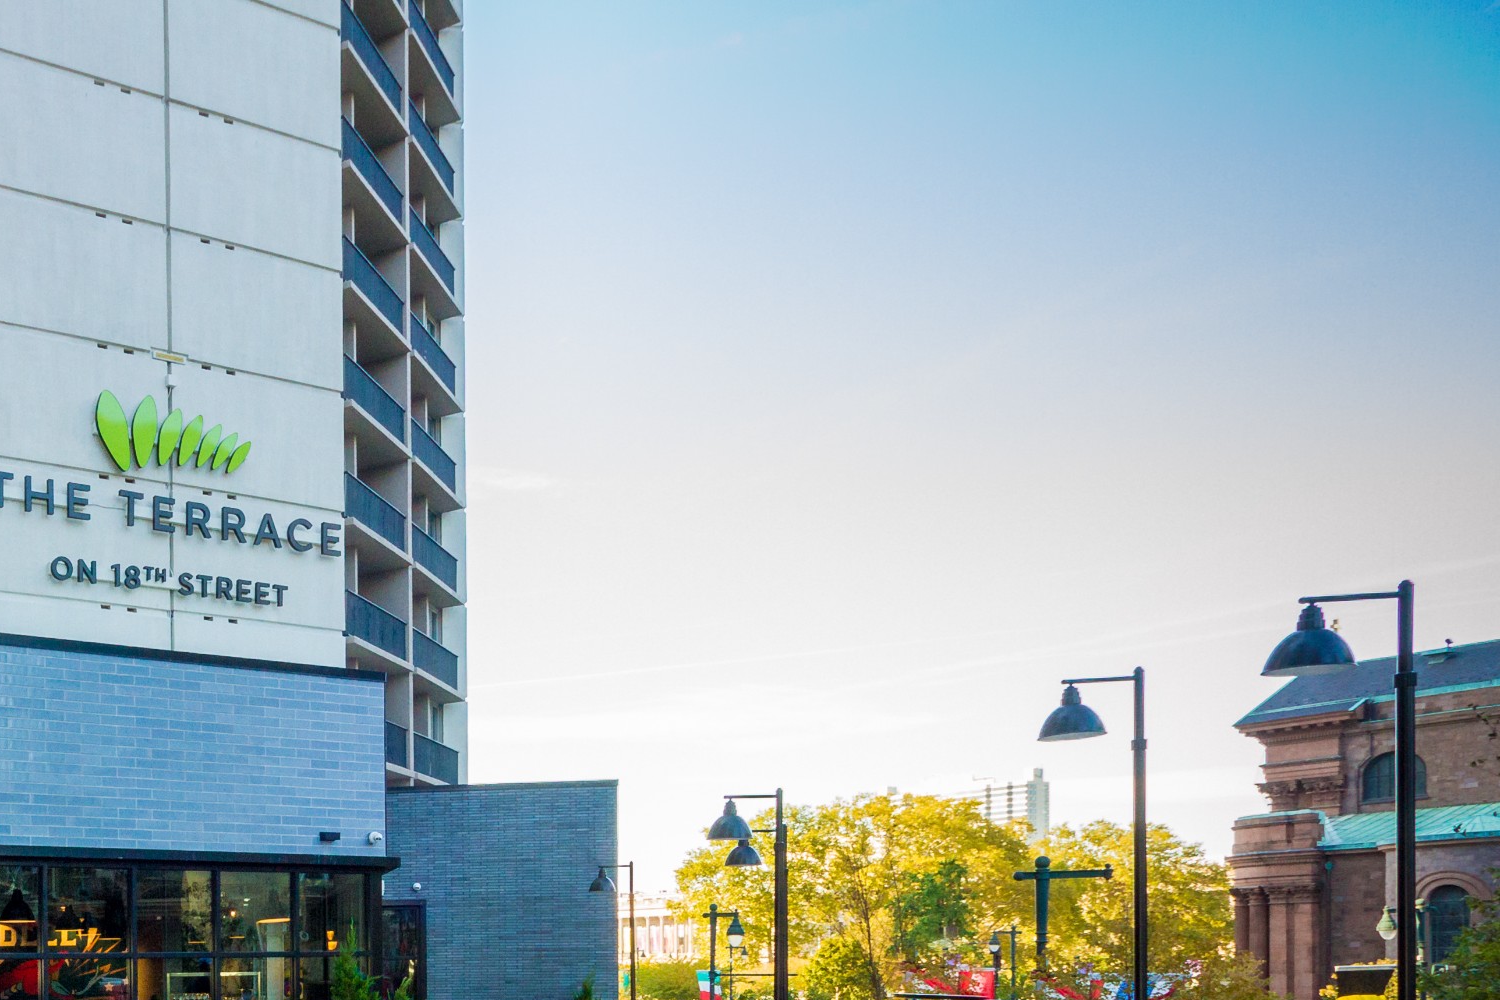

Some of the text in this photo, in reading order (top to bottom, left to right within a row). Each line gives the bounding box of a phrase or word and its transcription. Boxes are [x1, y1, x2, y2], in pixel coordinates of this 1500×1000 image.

[118, 489, 342, 557] TERRACE
[50, 556, 289, 607] ON 18TH STREET
